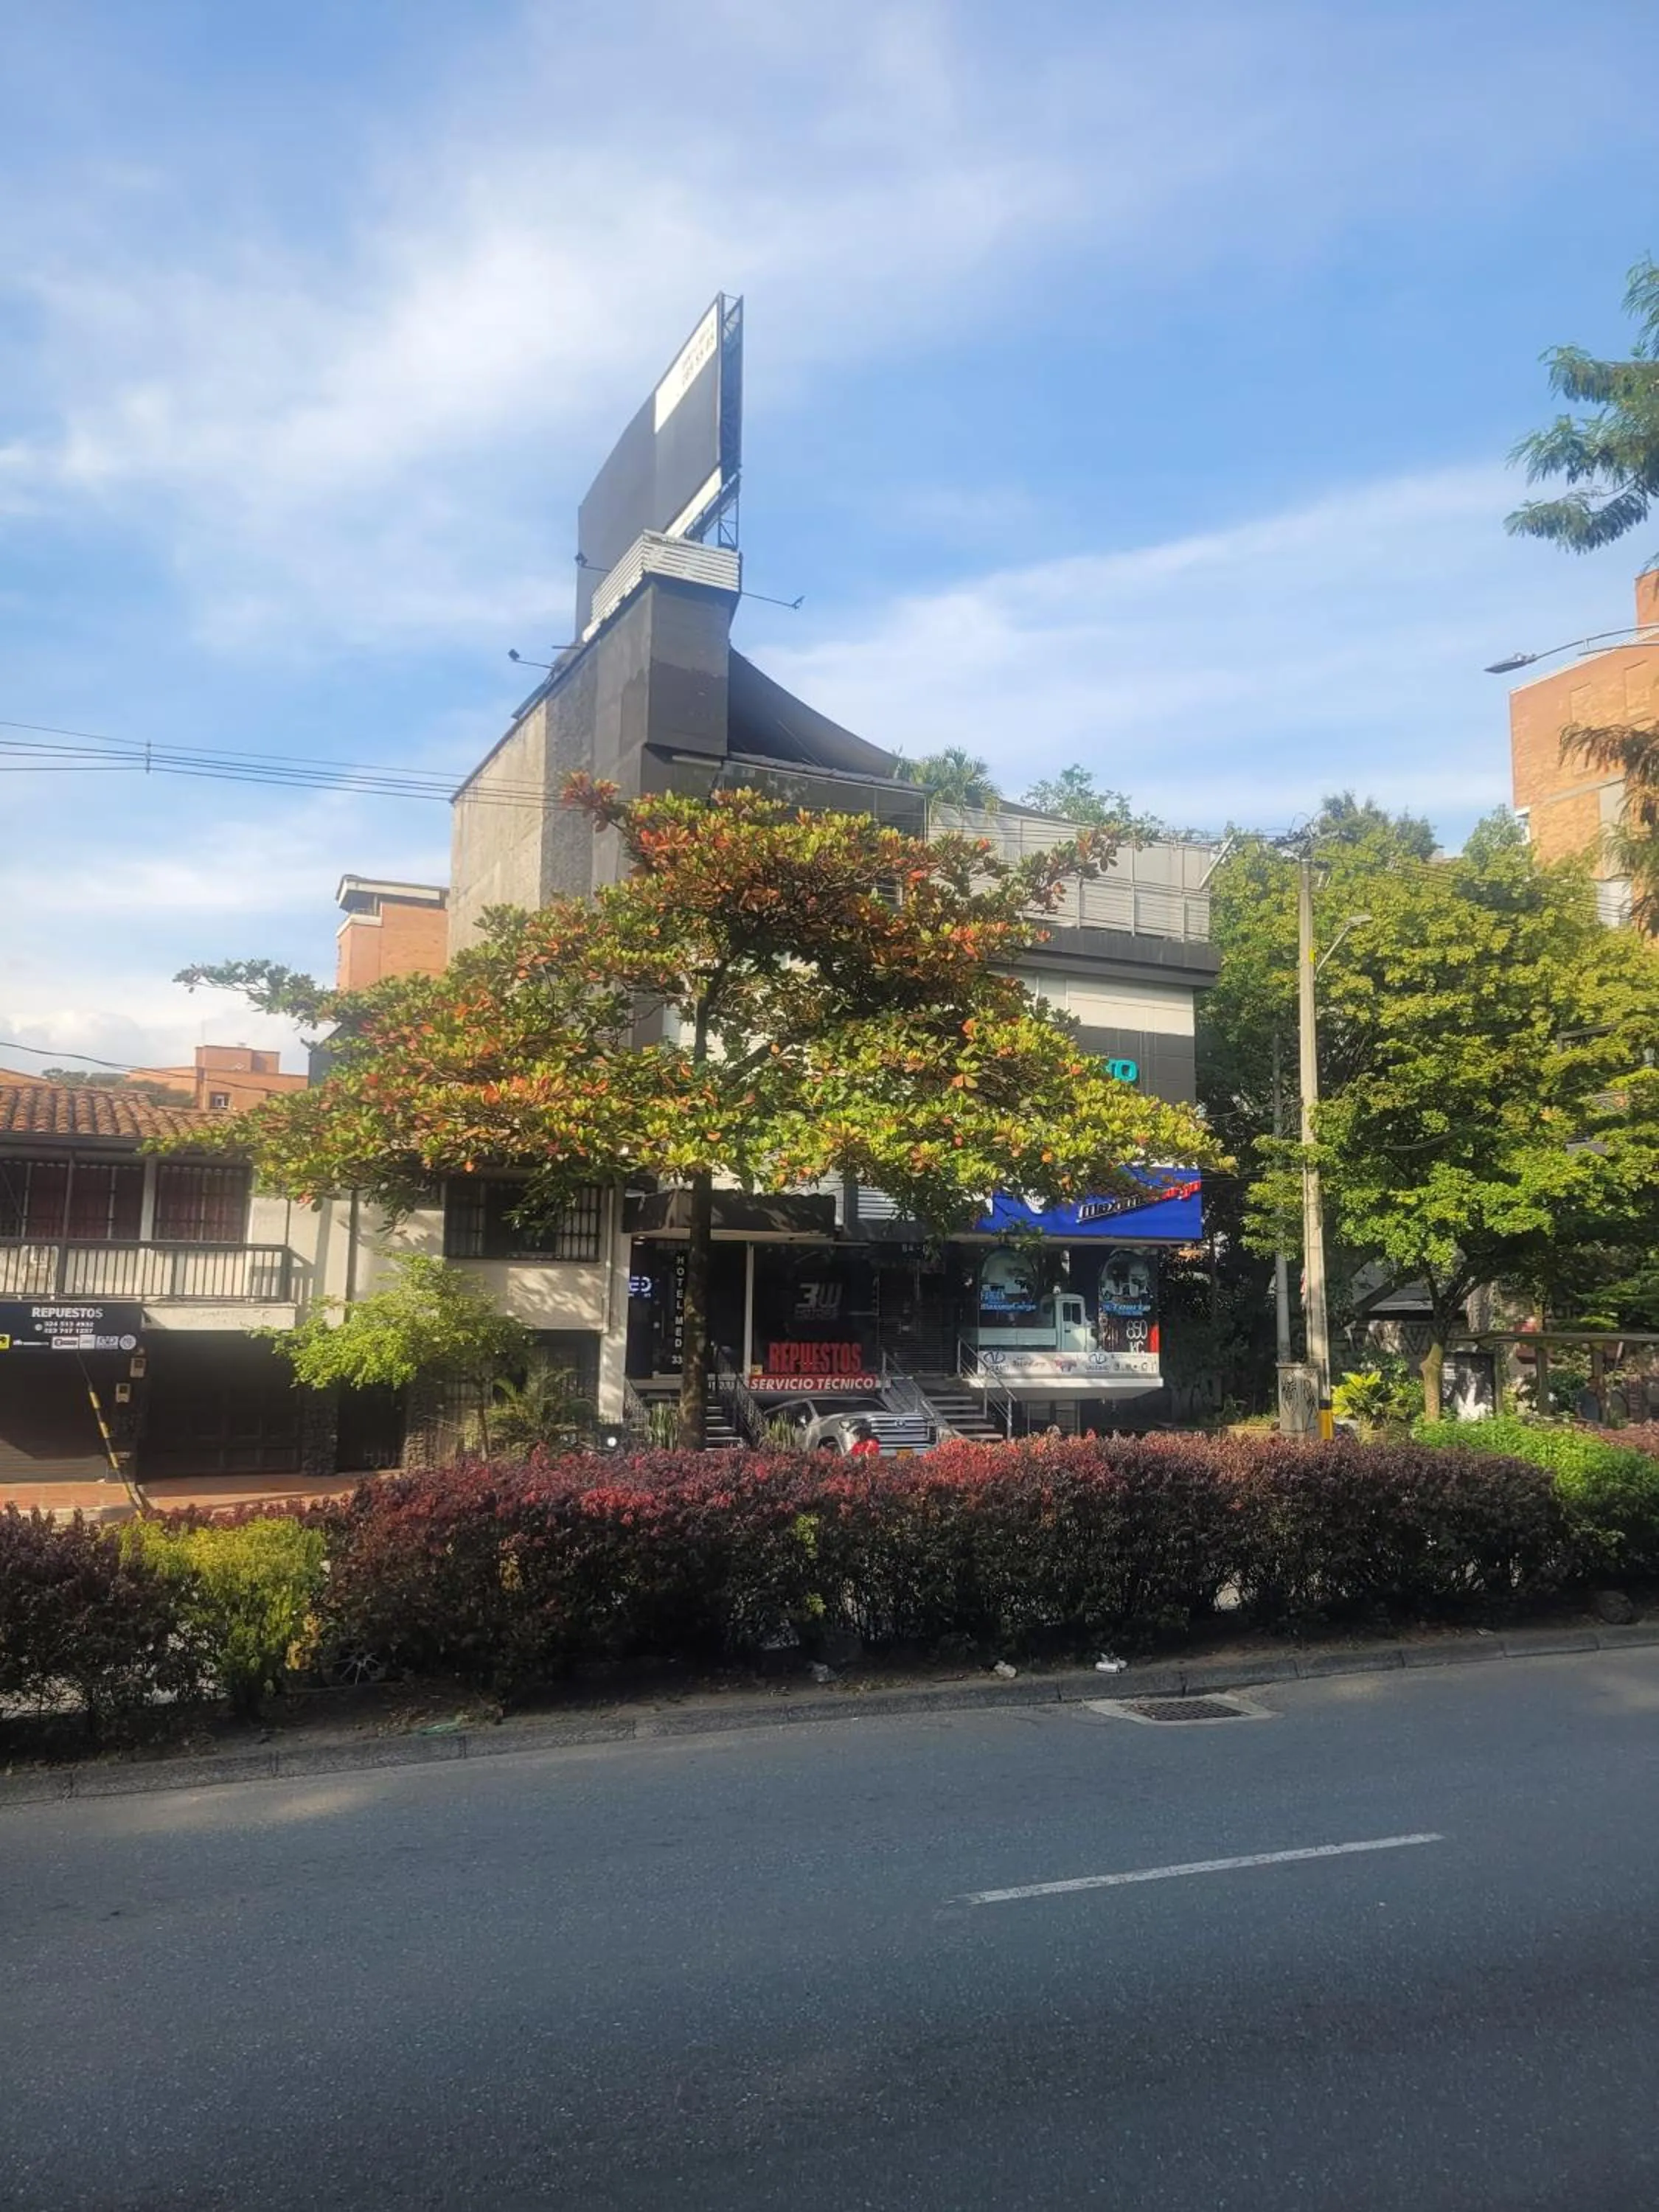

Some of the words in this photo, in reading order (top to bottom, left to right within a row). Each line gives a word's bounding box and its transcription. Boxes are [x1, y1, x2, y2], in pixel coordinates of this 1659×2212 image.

[628, 1276, 652, 1293] ED
[676, 1256, 685, 1310] HOTEL
[32, 1307, 104, 1319] REPUESTOS
[675, 1316, 684, 1348] MED
[1127, 1320, 1147, 1340] 850
[769, 1342, 862, 1373] REPUESTOS
[750, 1377, 814, 1390] SERVICIO
